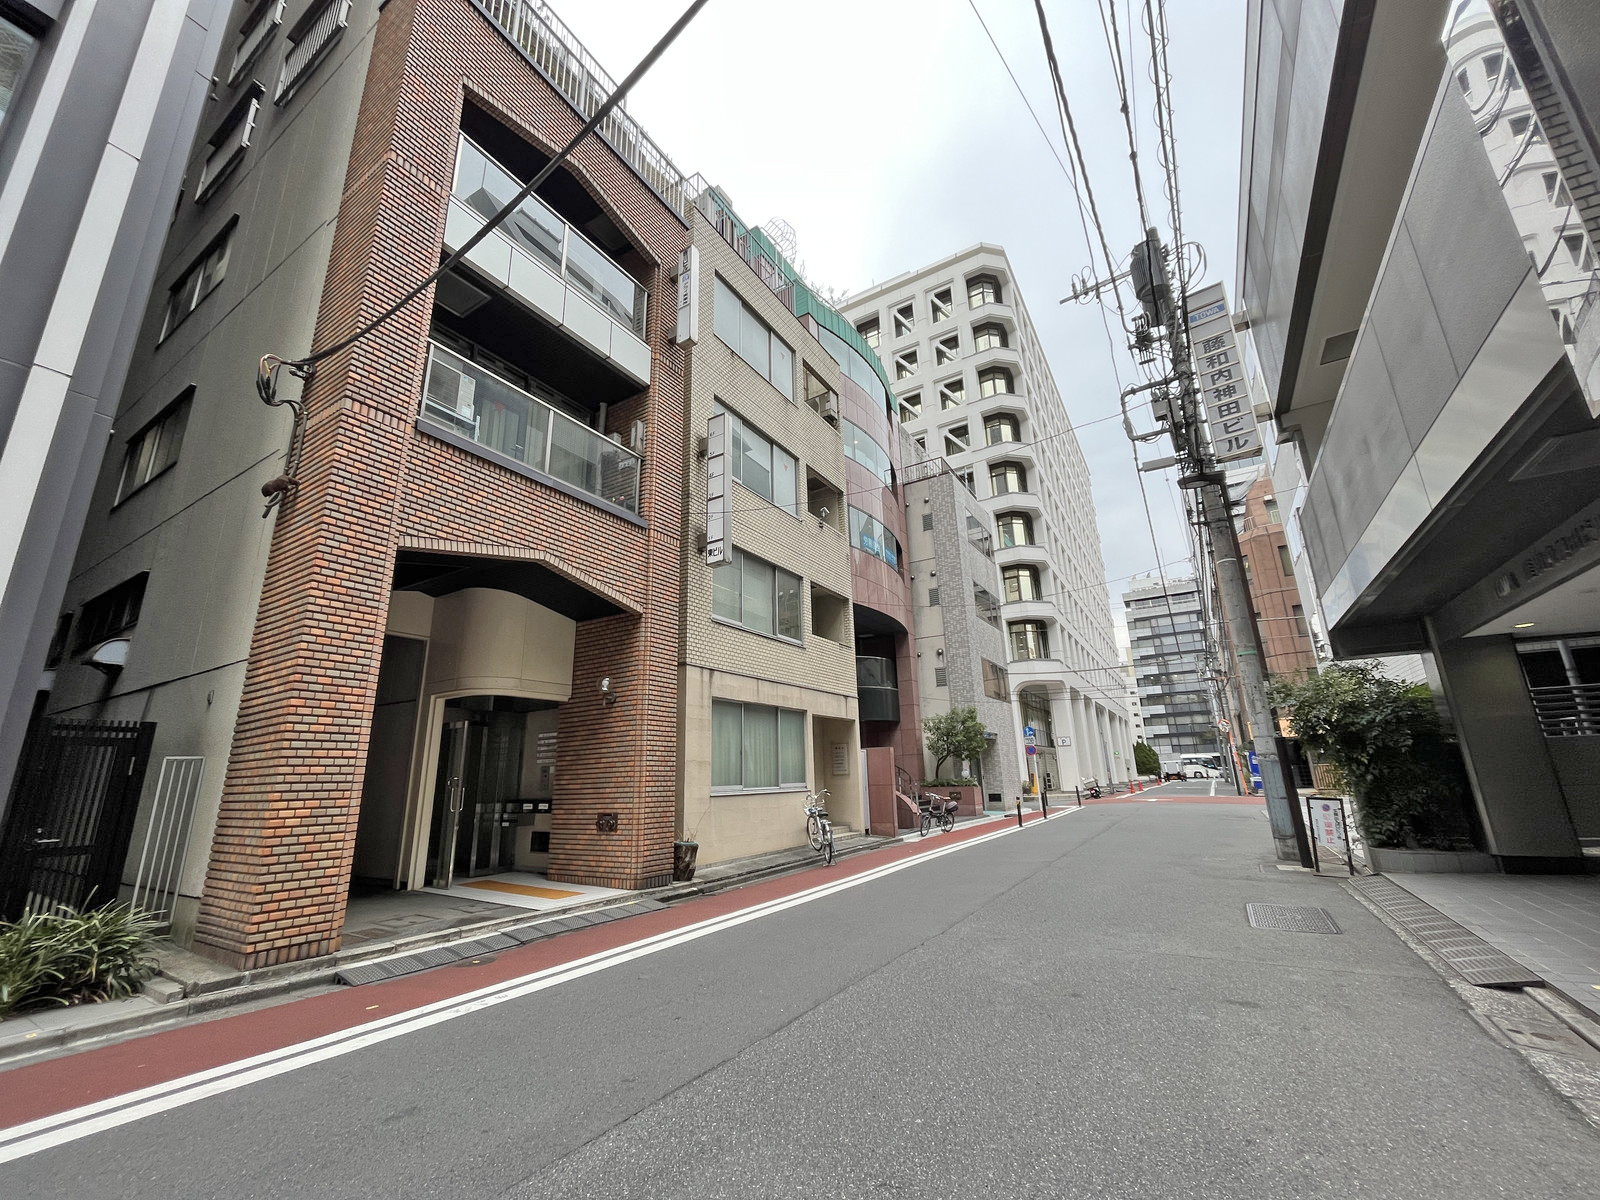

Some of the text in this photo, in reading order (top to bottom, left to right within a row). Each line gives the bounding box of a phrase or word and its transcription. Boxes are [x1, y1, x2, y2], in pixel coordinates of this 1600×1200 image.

[1196, 306, 1220, 321] TOWA
[1202, 335, 1249, 452] 藤和内神田ビル
